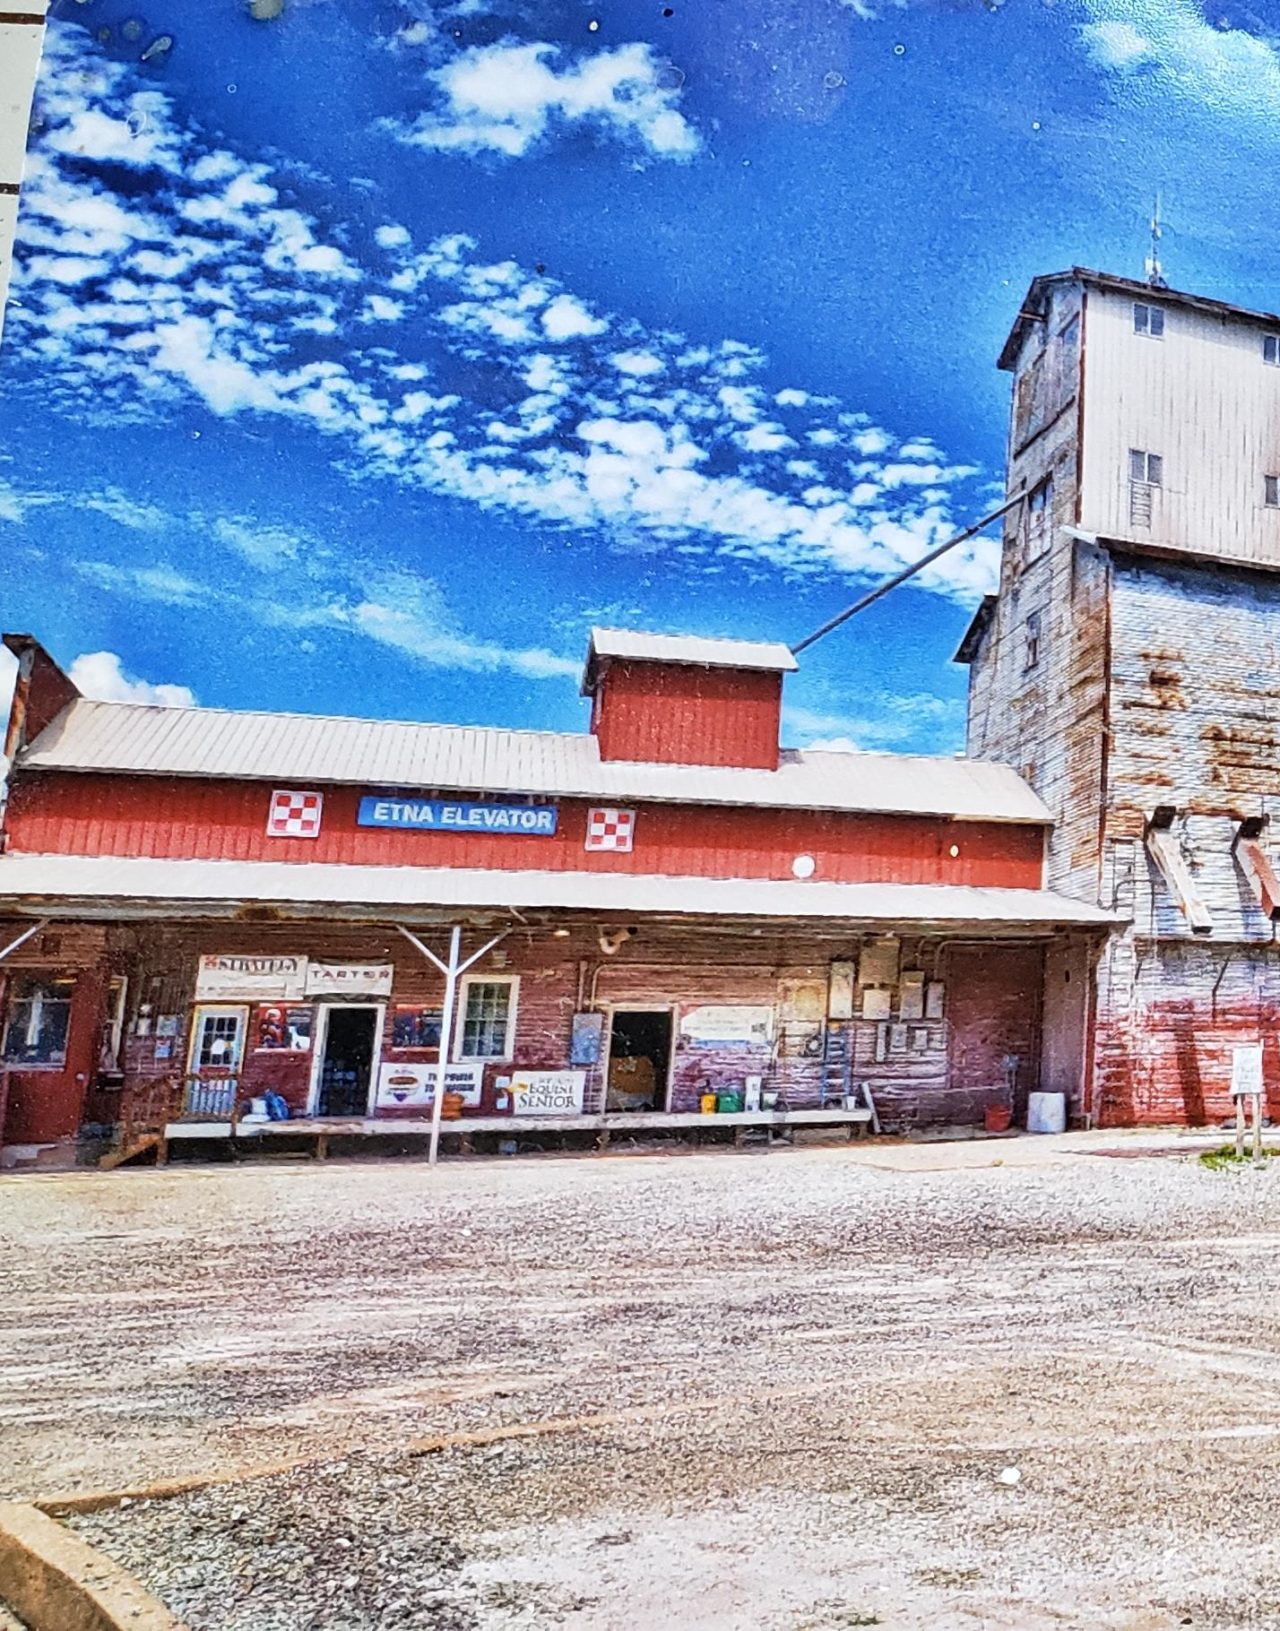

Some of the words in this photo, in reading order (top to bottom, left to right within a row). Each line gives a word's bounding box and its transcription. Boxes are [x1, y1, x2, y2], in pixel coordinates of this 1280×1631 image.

[373, 803, 434, 823] ETNA
[440, 807, 552, 829] ELEVATOR
[518, 1093, 577, 1109] SENIOR
